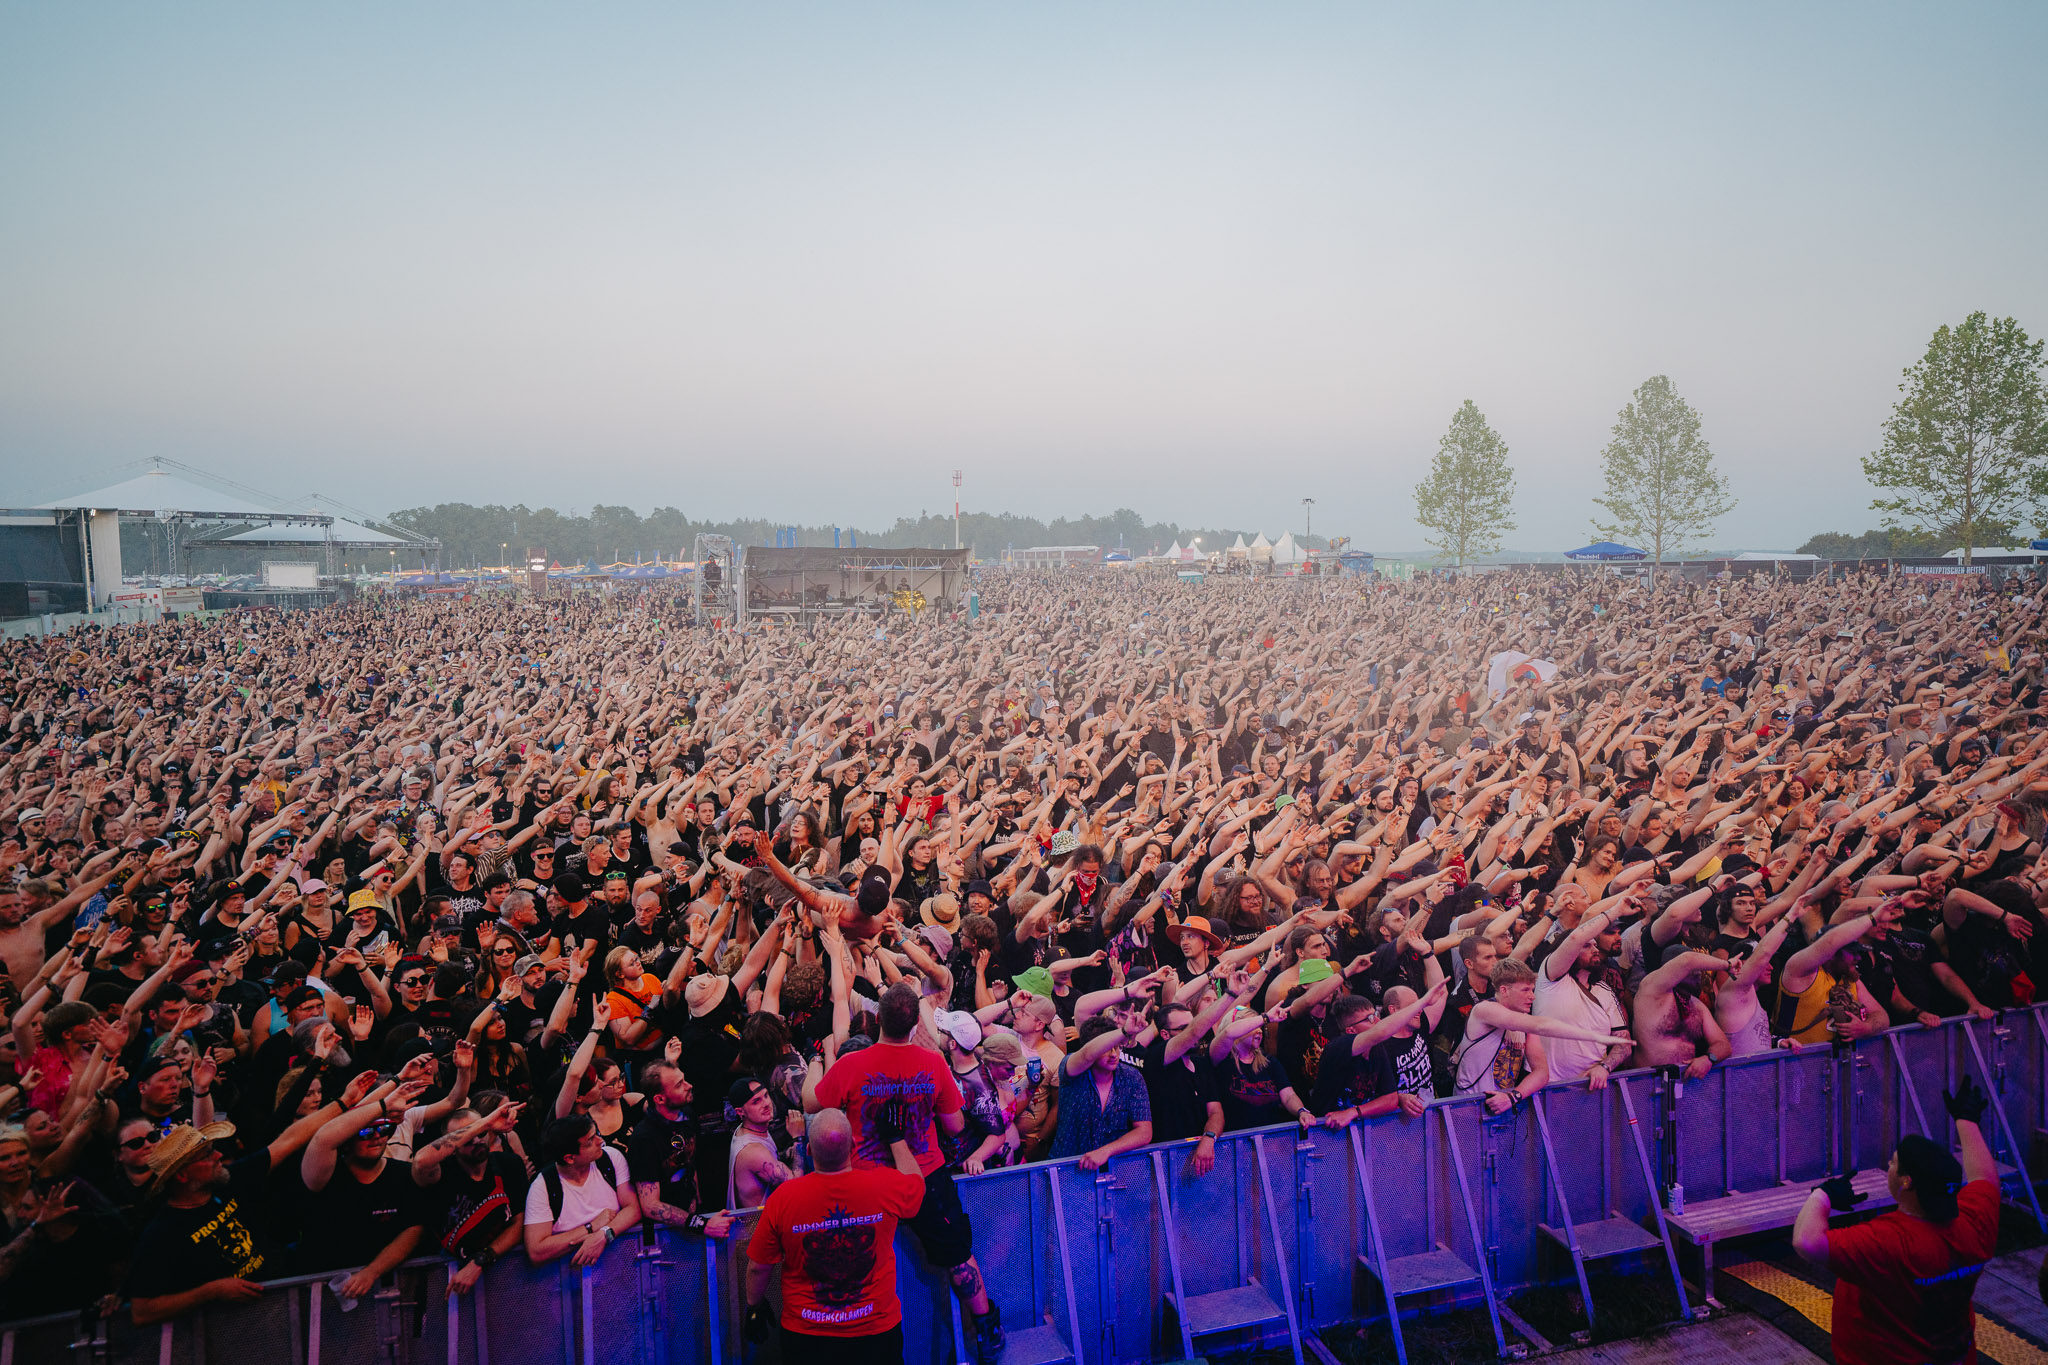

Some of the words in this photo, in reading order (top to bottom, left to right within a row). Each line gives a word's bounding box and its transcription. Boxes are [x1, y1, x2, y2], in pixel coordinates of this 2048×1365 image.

[1906, 566, 1914, 574] DIE
[1915, 566, 1965, 574] APOKALYPTISCHEN
[1967, 566, 1986, 574] REITER
[1058, 948, 1066, 957] P
[1397, 1054, 1432, 1089] ALTER
[792, 1219, 840, 1233] SUMMER
[841, 1212, 883, 1227] BREEZE
[801, 1302, 873, 1323] GRABENSCHLAMPEN
